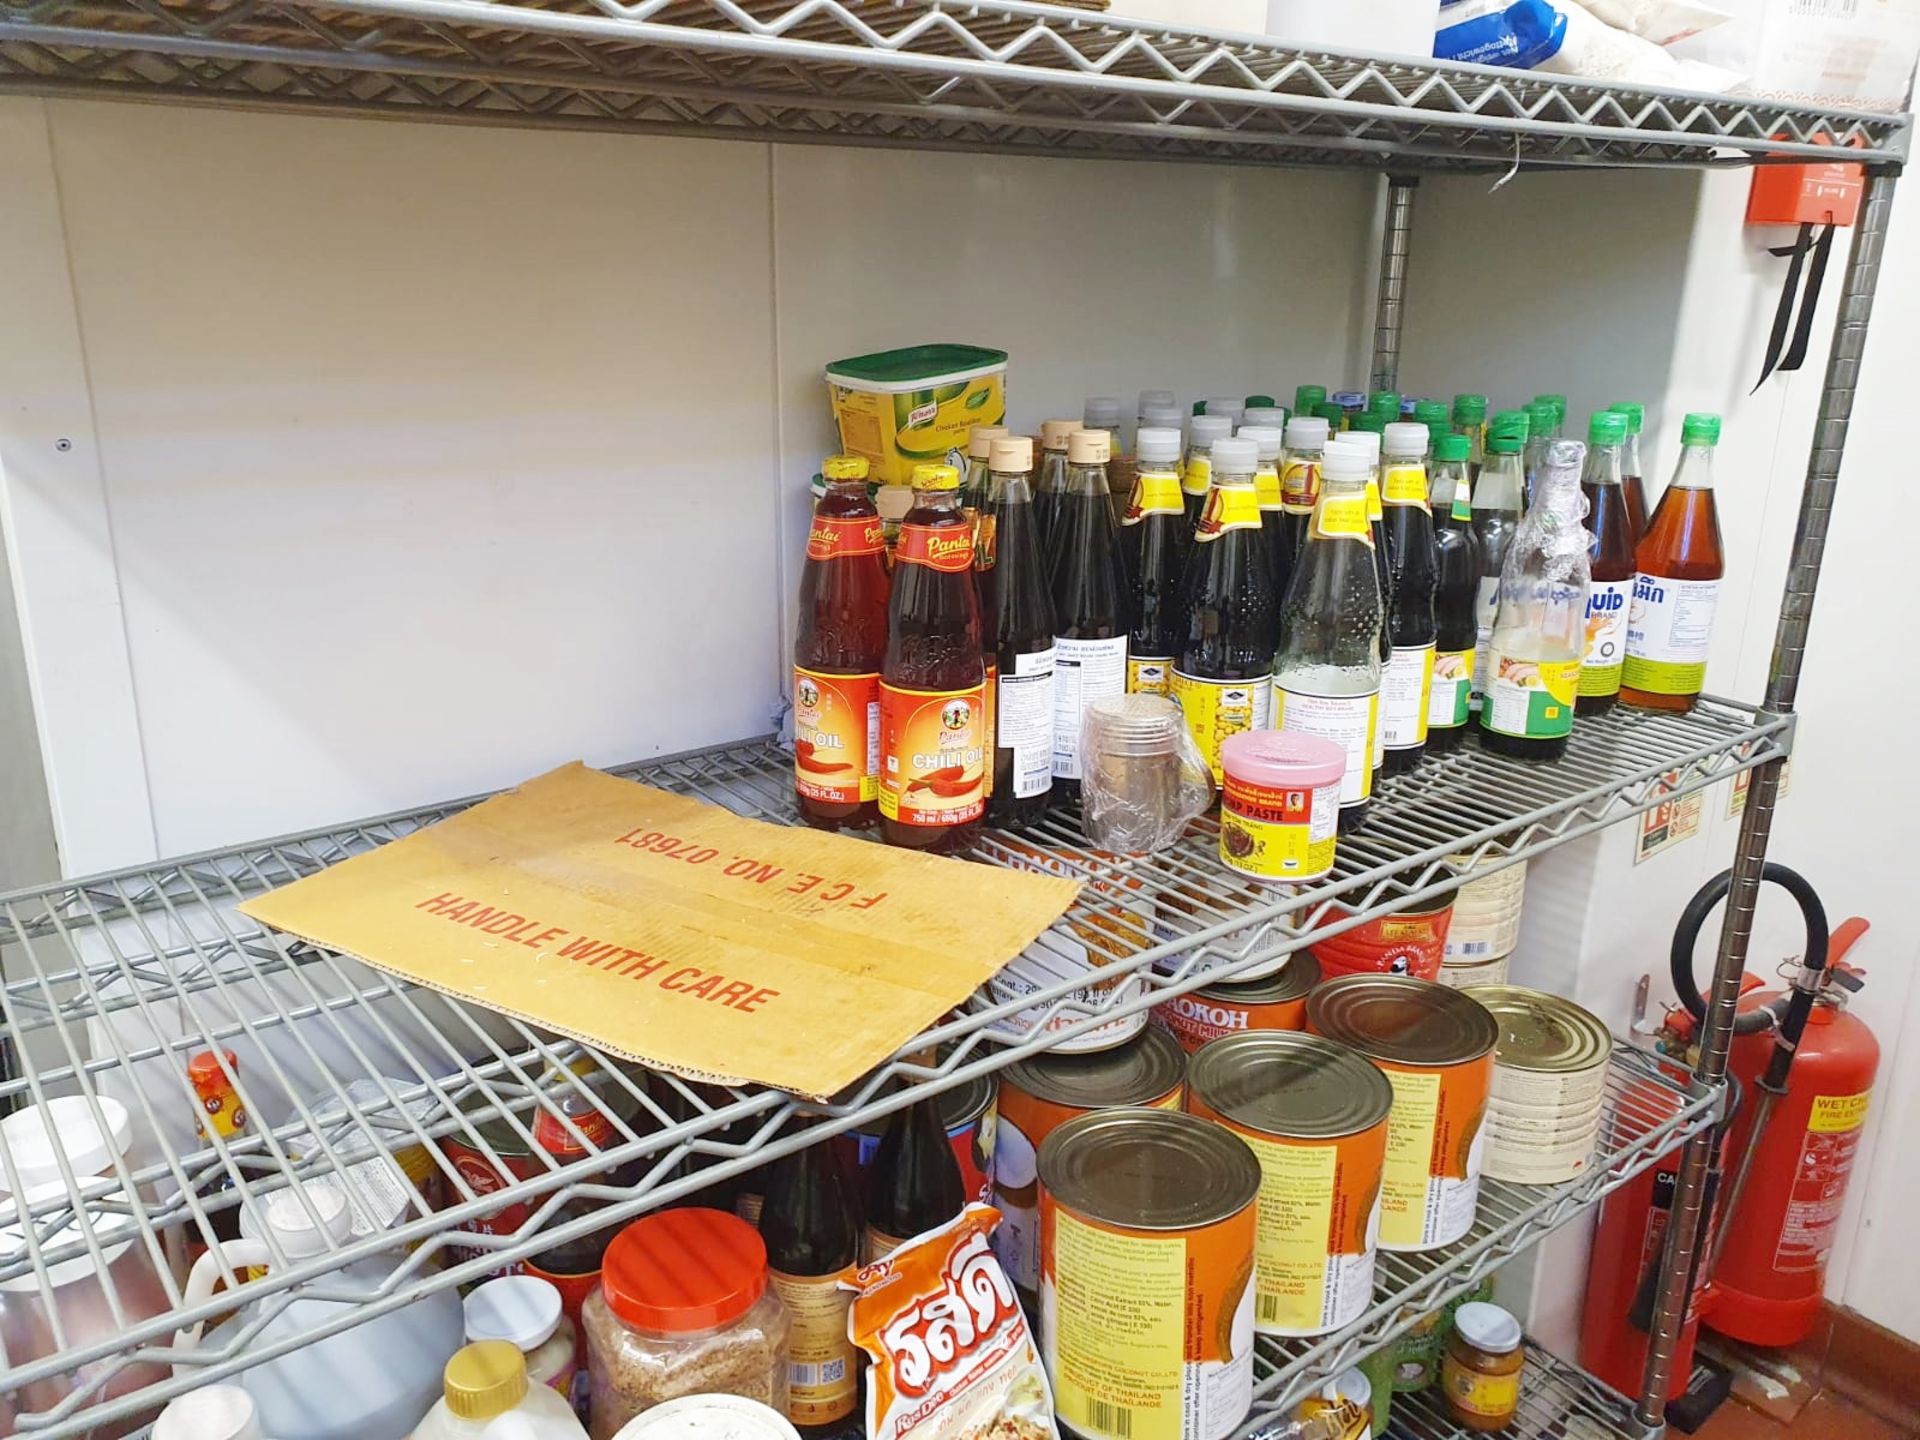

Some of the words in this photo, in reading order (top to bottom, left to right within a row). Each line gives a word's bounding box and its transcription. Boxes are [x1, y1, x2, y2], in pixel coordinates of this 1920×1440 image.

[815, 733, 845, 749] OIL
[912, 752, 961, 769] CHILI
[1246, 804, 1283, 821] PASTE
[613, 827, 721, 865] 07681
[721, 855, 785, 884] NO.
[415, 892, 568, 949] HANDLE
[555, 936, 670, 980] WITH
[658, 967, 781, 1014] CARE
[1817, 1098, 1847, 1110] WET
[1820, 1110, 1842, 1119] FIRE
[1264, 1278, 1305, 1289] THAILAND
[885, 1231, 1015, 1388] รสดี
[1097, 1390, 1109, 1400] DE
[1102, 1382, 1114, 1392] OF
[1115, 1387, 1162, 1400] THAILAND
